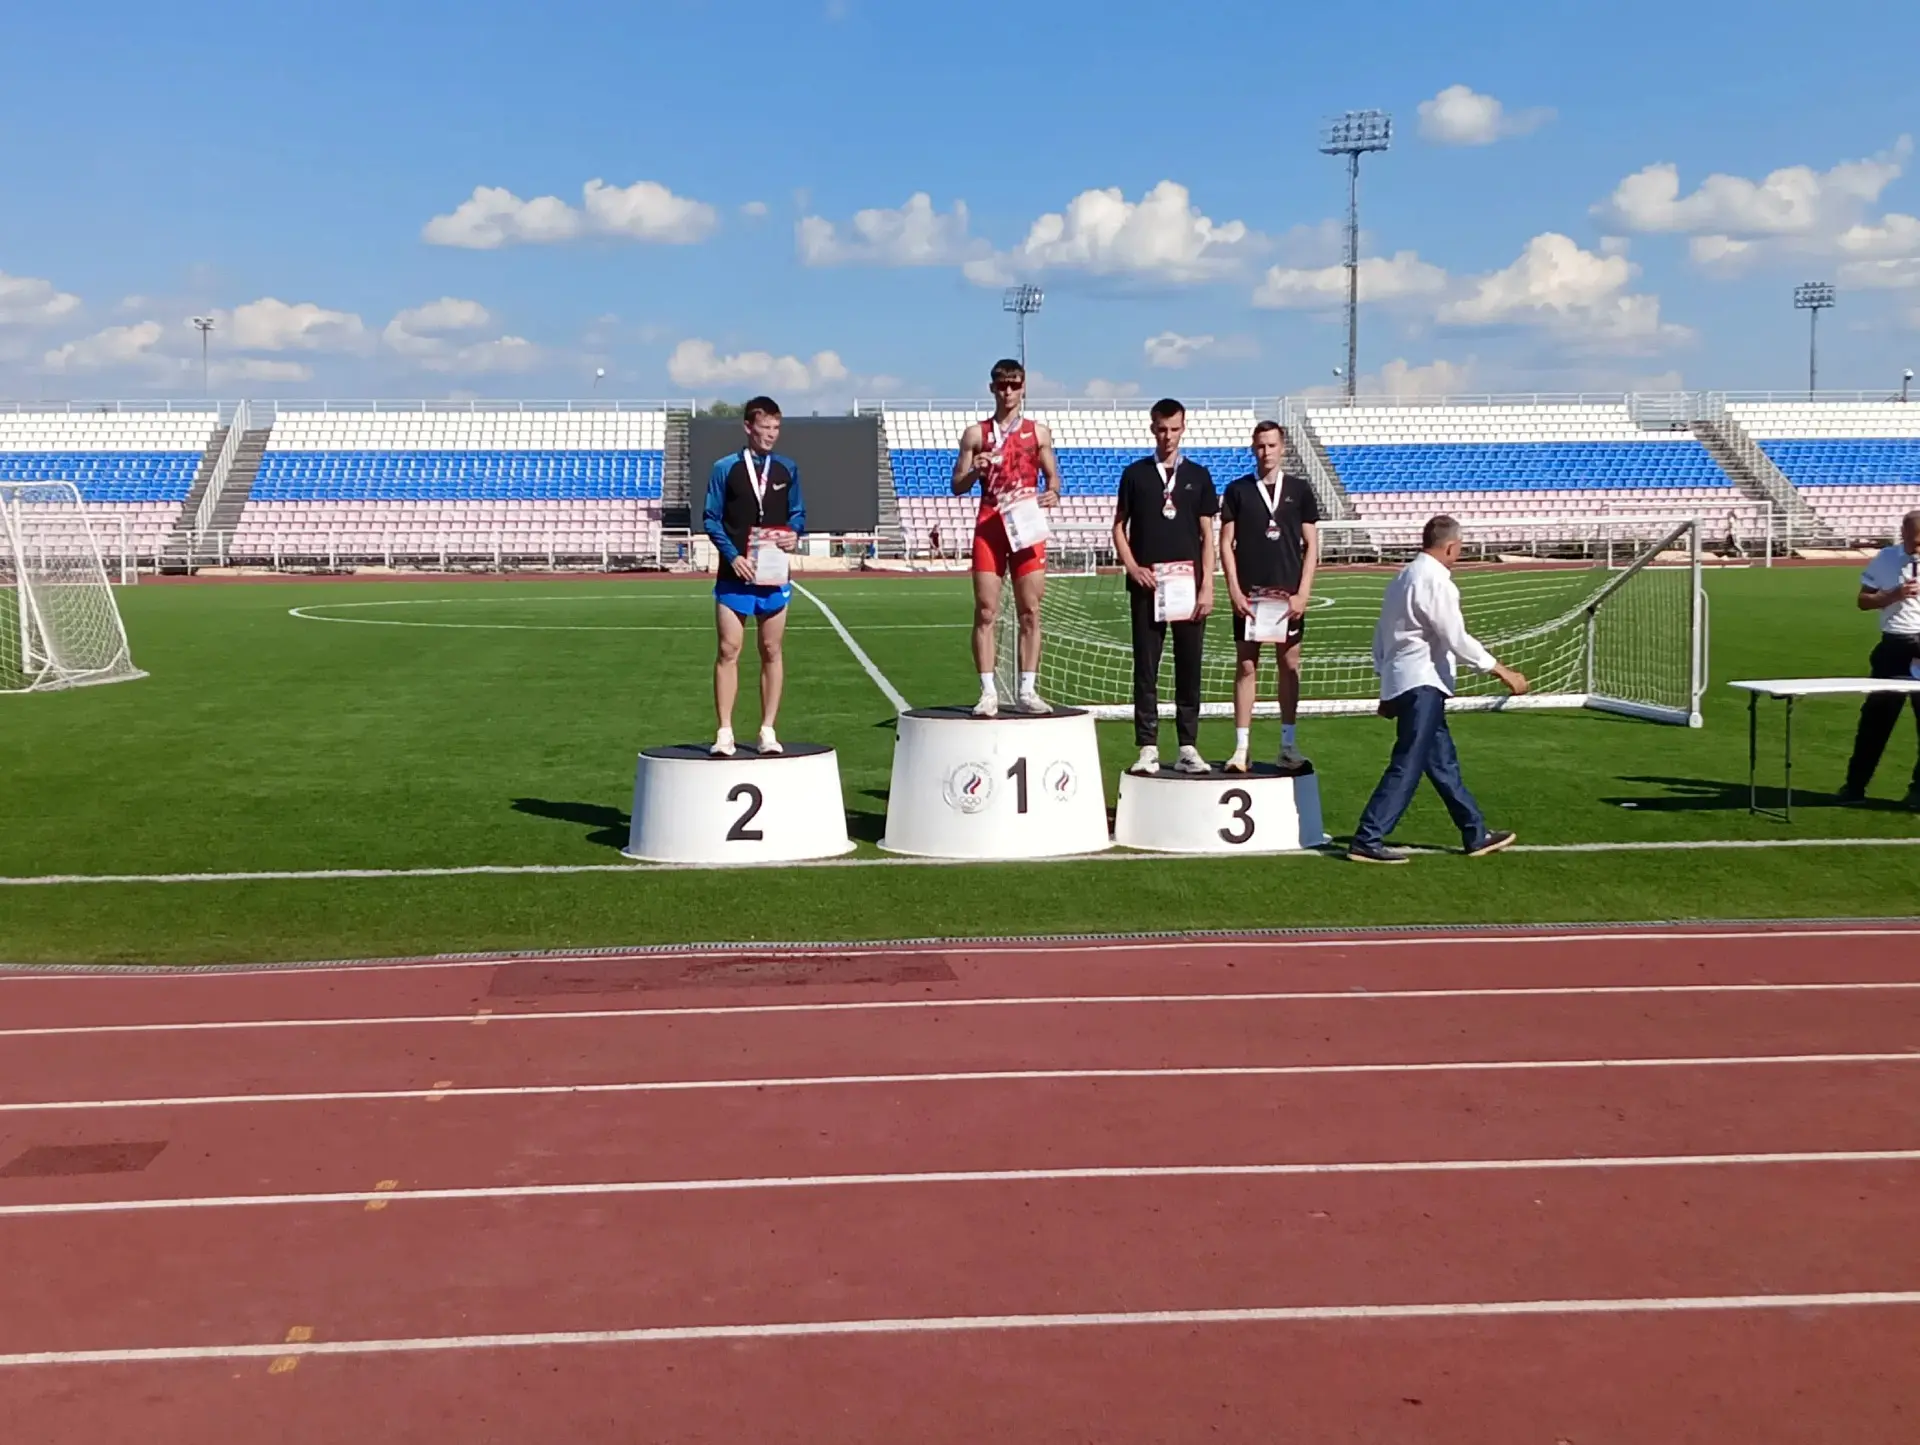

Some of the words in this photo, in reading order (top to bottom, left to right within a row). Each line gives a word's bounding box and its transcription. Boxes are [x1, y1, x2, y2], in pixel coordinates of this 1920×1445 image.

[725, 783, 764, 842] 2
[1006, 757, 1028, 814] 1
[1218, 788, 1255, 845] 3
